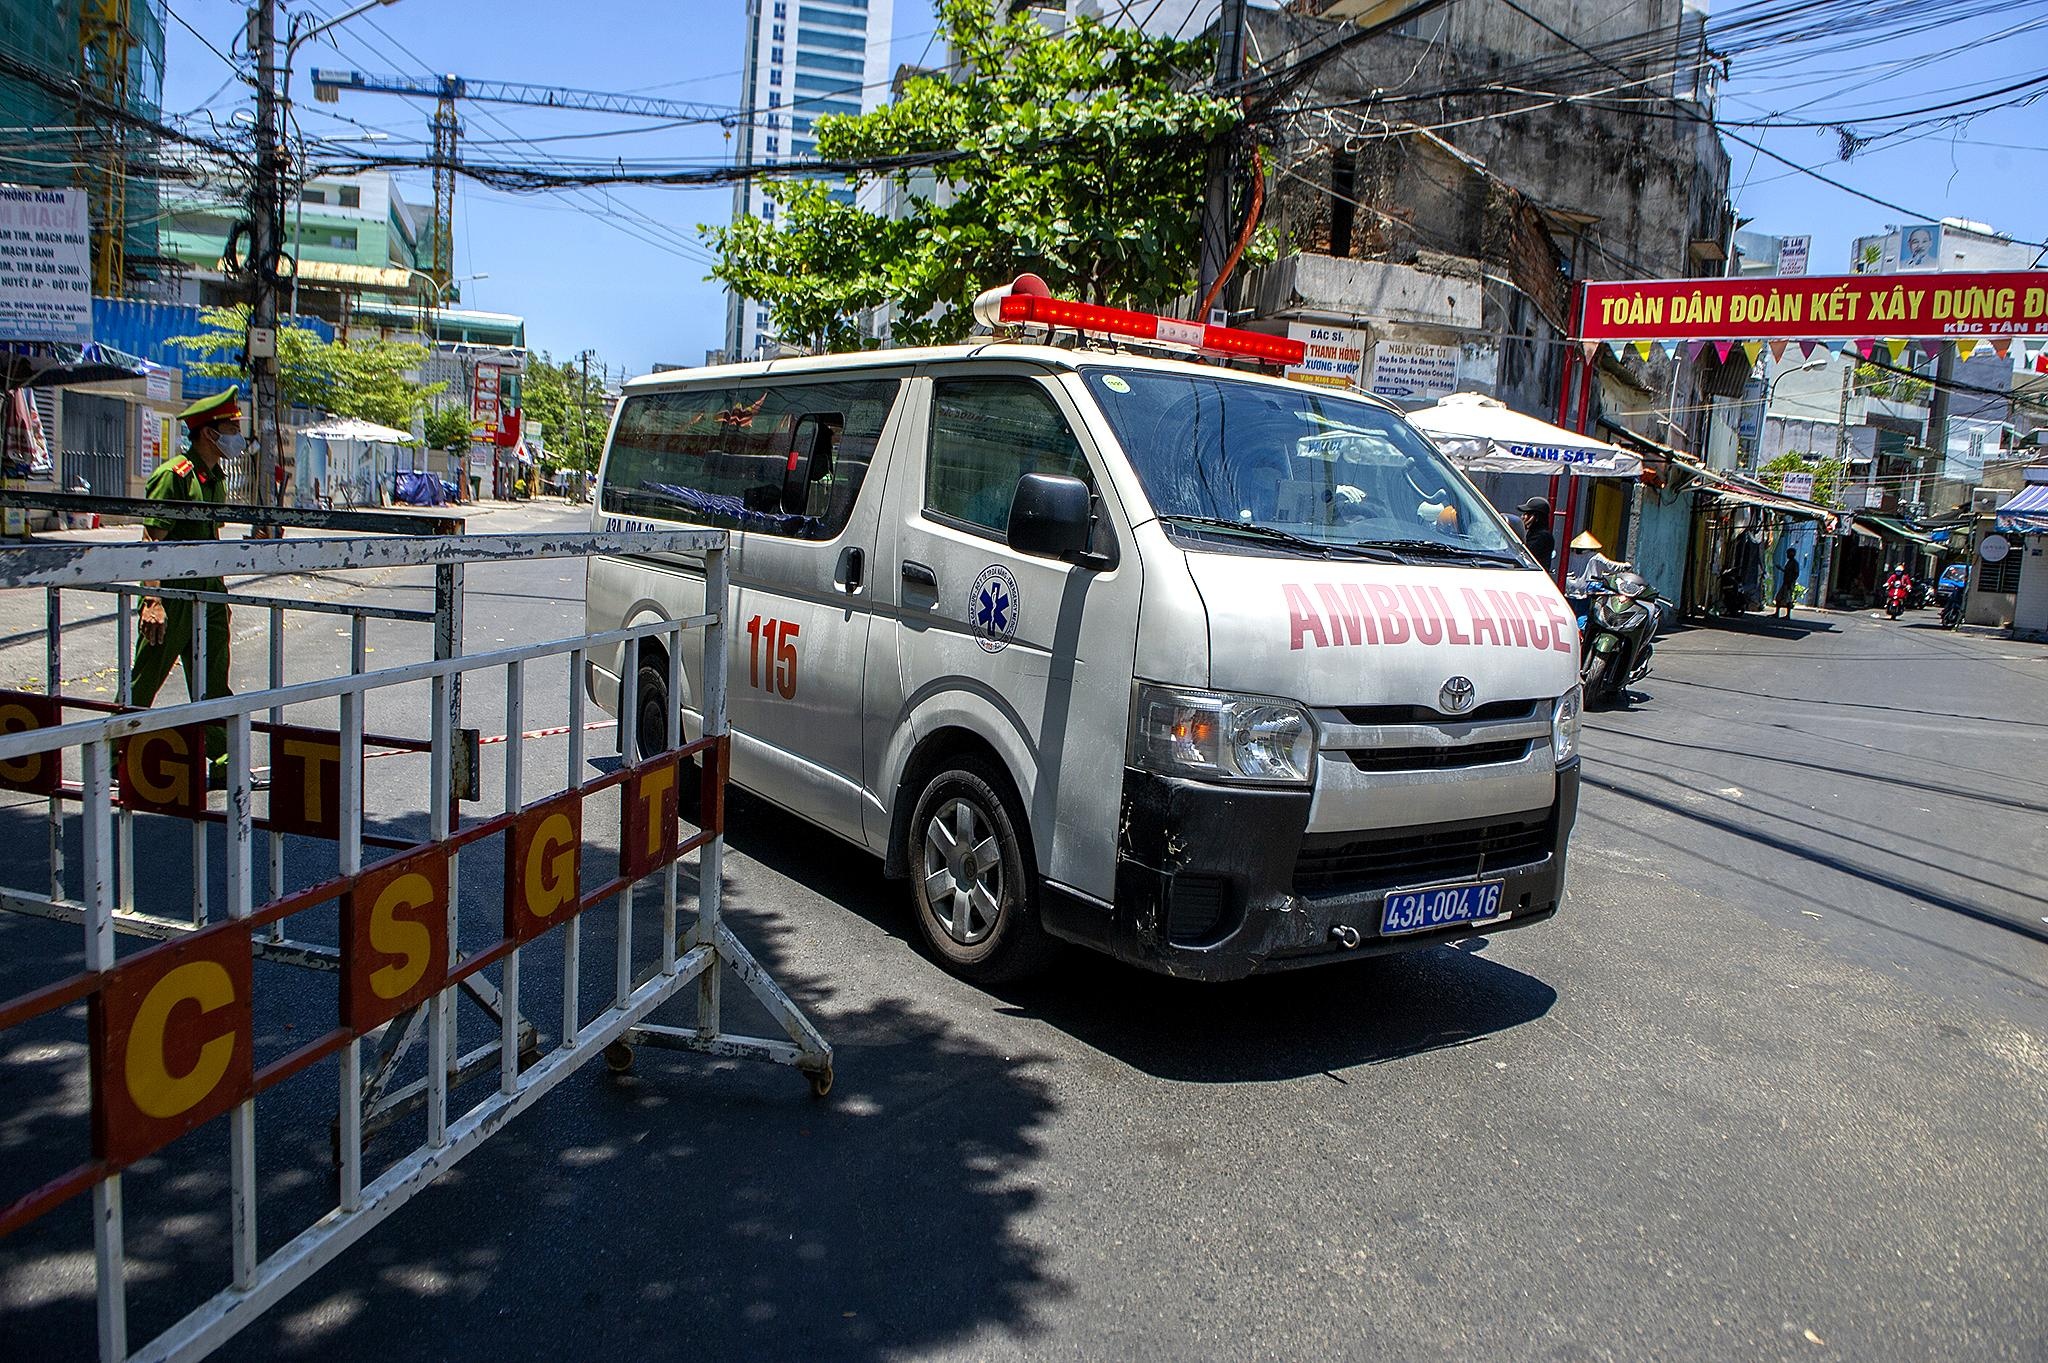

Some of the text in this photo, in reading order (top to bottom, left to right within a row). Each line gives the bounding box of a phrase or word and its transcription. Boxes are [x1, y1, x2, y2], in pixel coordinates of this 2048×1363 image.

[35, 189, 65, 205] KHÁM
[35, 231, 62, 245] MẠCH
[1, 245, 28, 259] MẠCH
[16, 262, 33, 273] TIM
[57, 263, 80, 275] SINH
[1601, 291, 1664, 325] TOÀN
[1670, 289, 1723, 324] DÂN
[1729, 289, 1803, 323] ĐOÀN
[1810, 282, 1861, 321] KẾT
[1868, 284, 1925, 321] XÂY
[1932, 286, 2016, 325] DỰNG
[1310, 329, 1330, 341] BÁC
[1943, 322, 1984, 333] KDC
[1989, 320, 2029, 333] TÂN
[1310, 344, 1338, 360] THANH
[1338, 343, 1361, 362] HỒNG
[1388, 343, 1413, 357] NHẬN
[1510, 442, 1596, 464] CẢNH SÁT
[1282, 583, 1571, 654] AMBULANCE
[746, 614, 800, 701] 115
[127, 727, 190, 807] G
[283, 738, 341, 823] T
[1386, 884, 1500, 930] 43A-004.16
[125, 765, 675, 1119] C S G T
